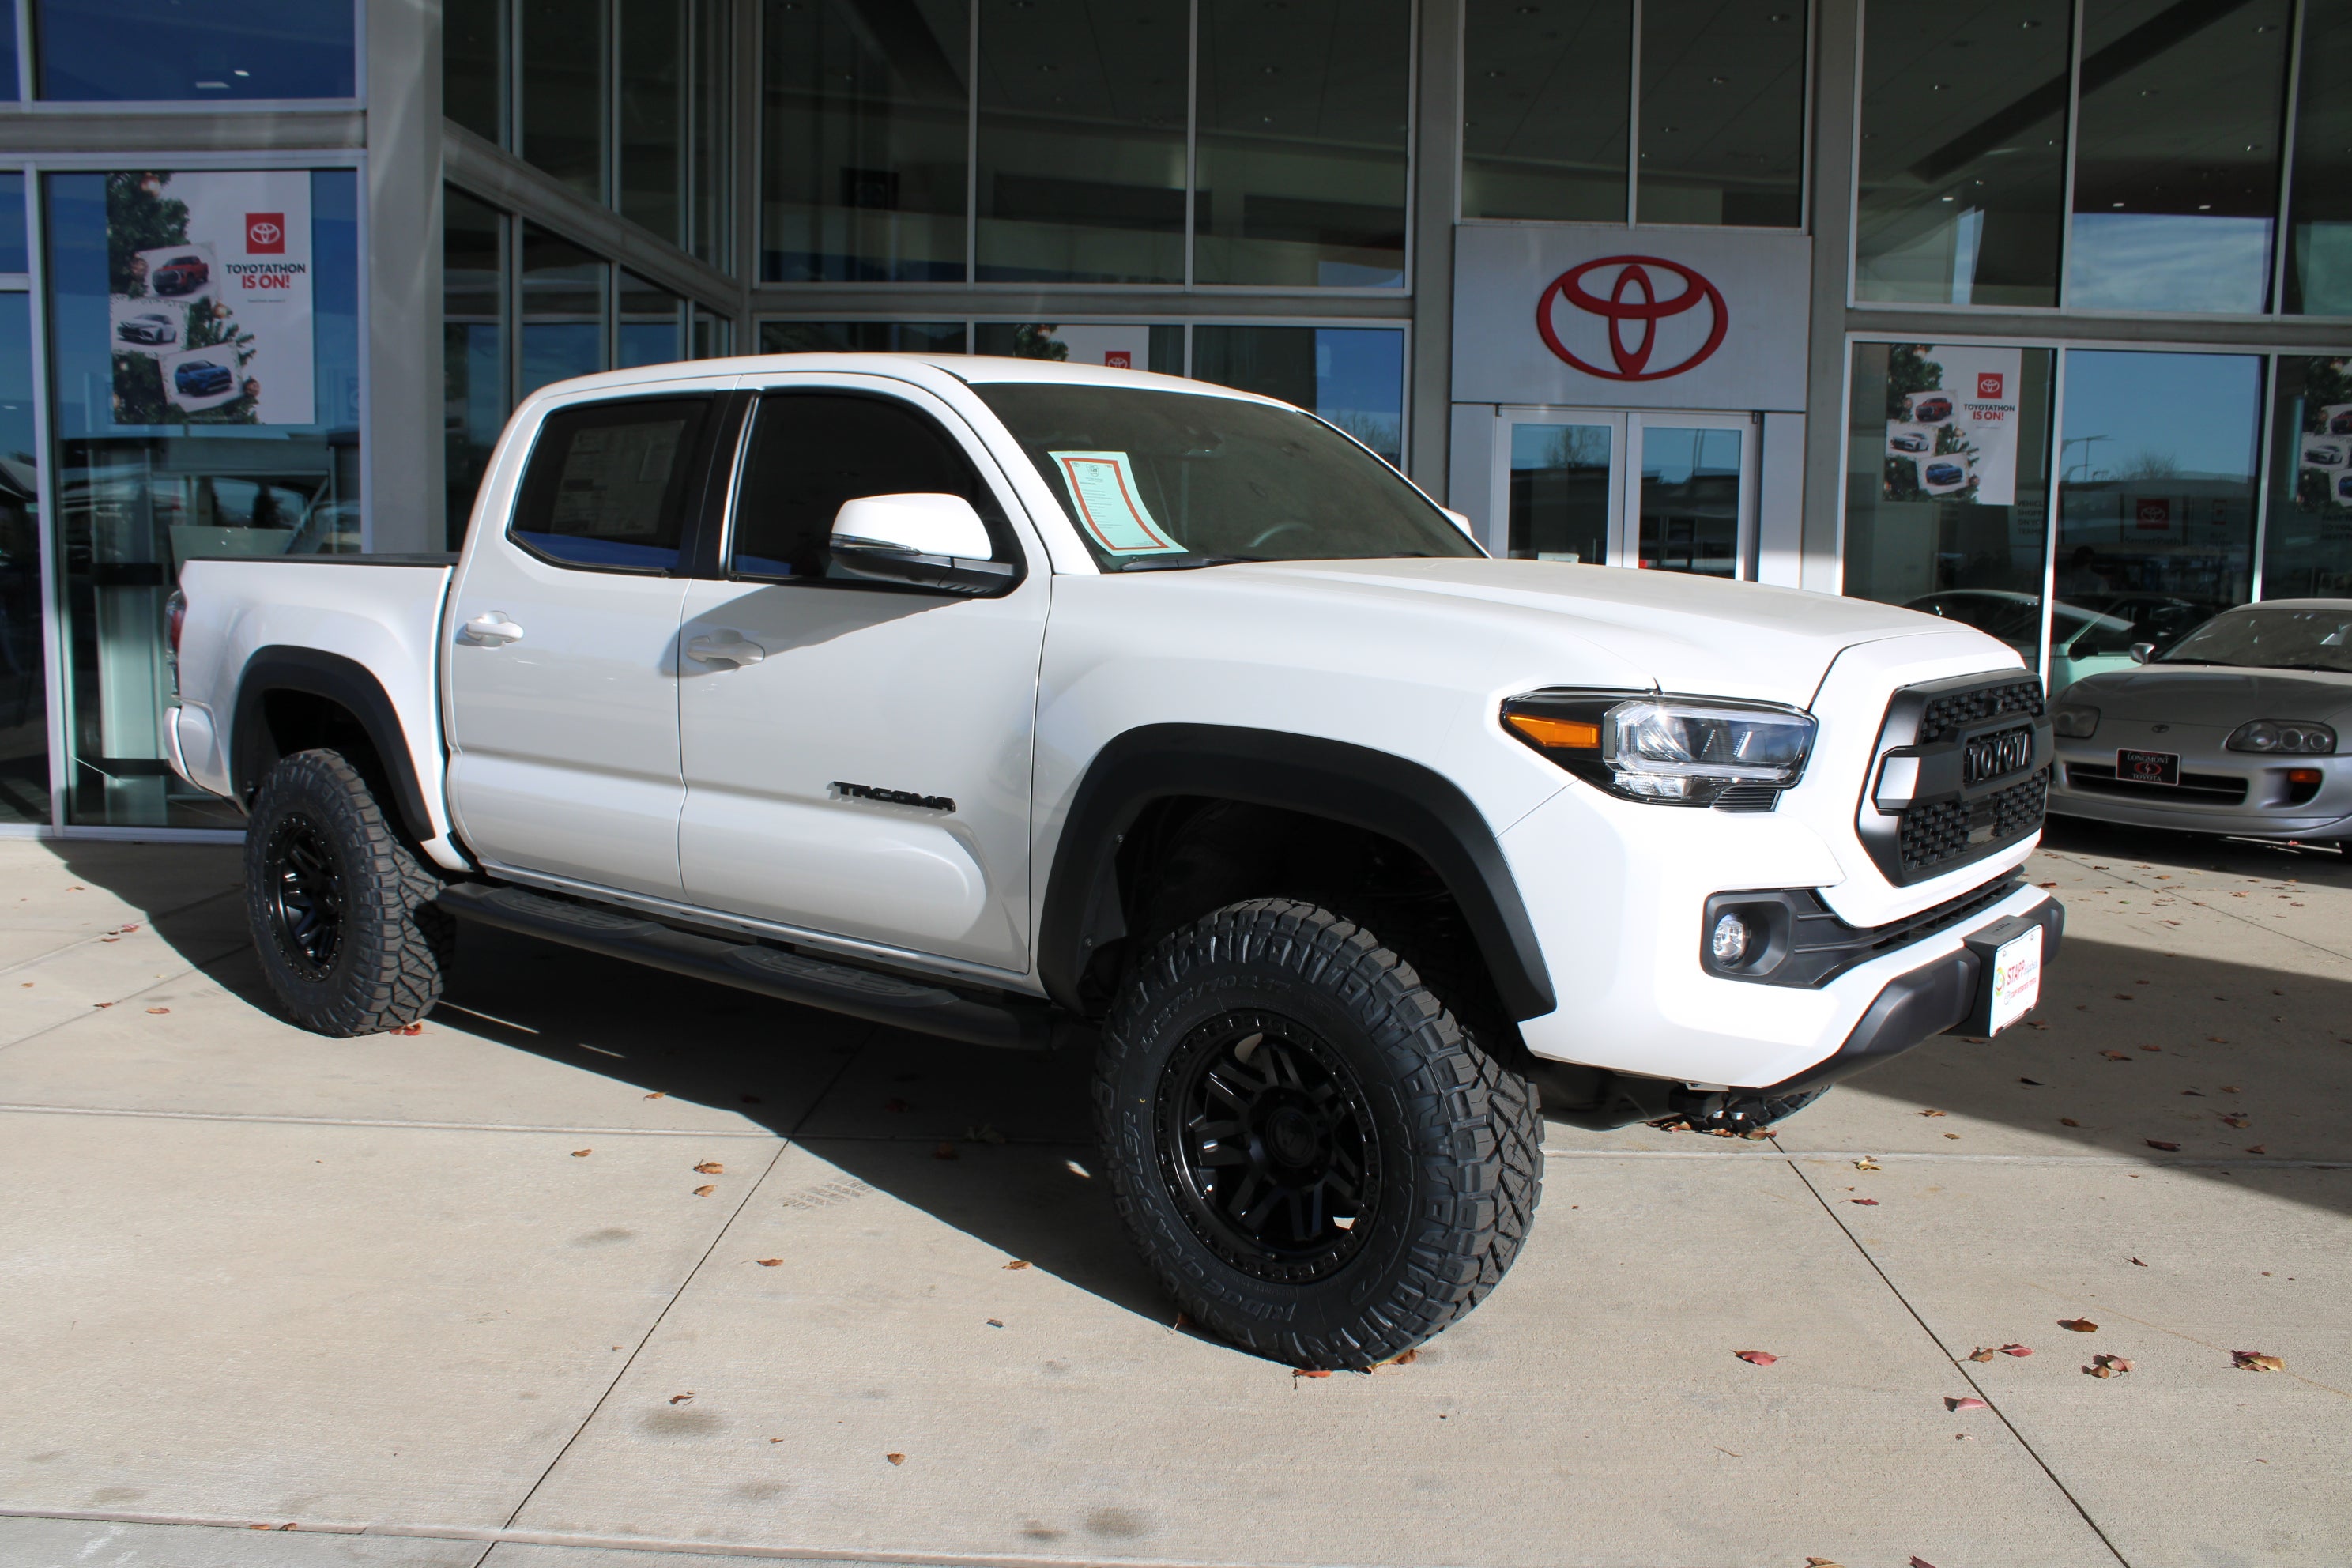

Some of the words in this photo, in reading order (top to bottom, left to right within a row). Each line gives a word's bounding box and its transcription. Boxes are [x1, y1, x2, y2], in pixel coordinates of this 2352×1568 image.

[226, 263, 306, 273] TOYOTATHON
[242, 274, 256, 288] IS
[259, 274, 290, 289] ON!
[1973, 411, 1982, 420] IS
[1984, 411, 2004, 420] ON!
[1966, 733, 2031, 782] TOYOTA
[2127, 752, 2169, 764] LONGMONT
[2132, 773, 2162, 782] TOYOTA
[832, 781, 956, 812] TACOMA
[2007, 959, 2025, 986] STAPP
[1121, 1110, 1204, 1279] GRAPPLER
[1201, 1280, 1297, 1322] RIDGE
